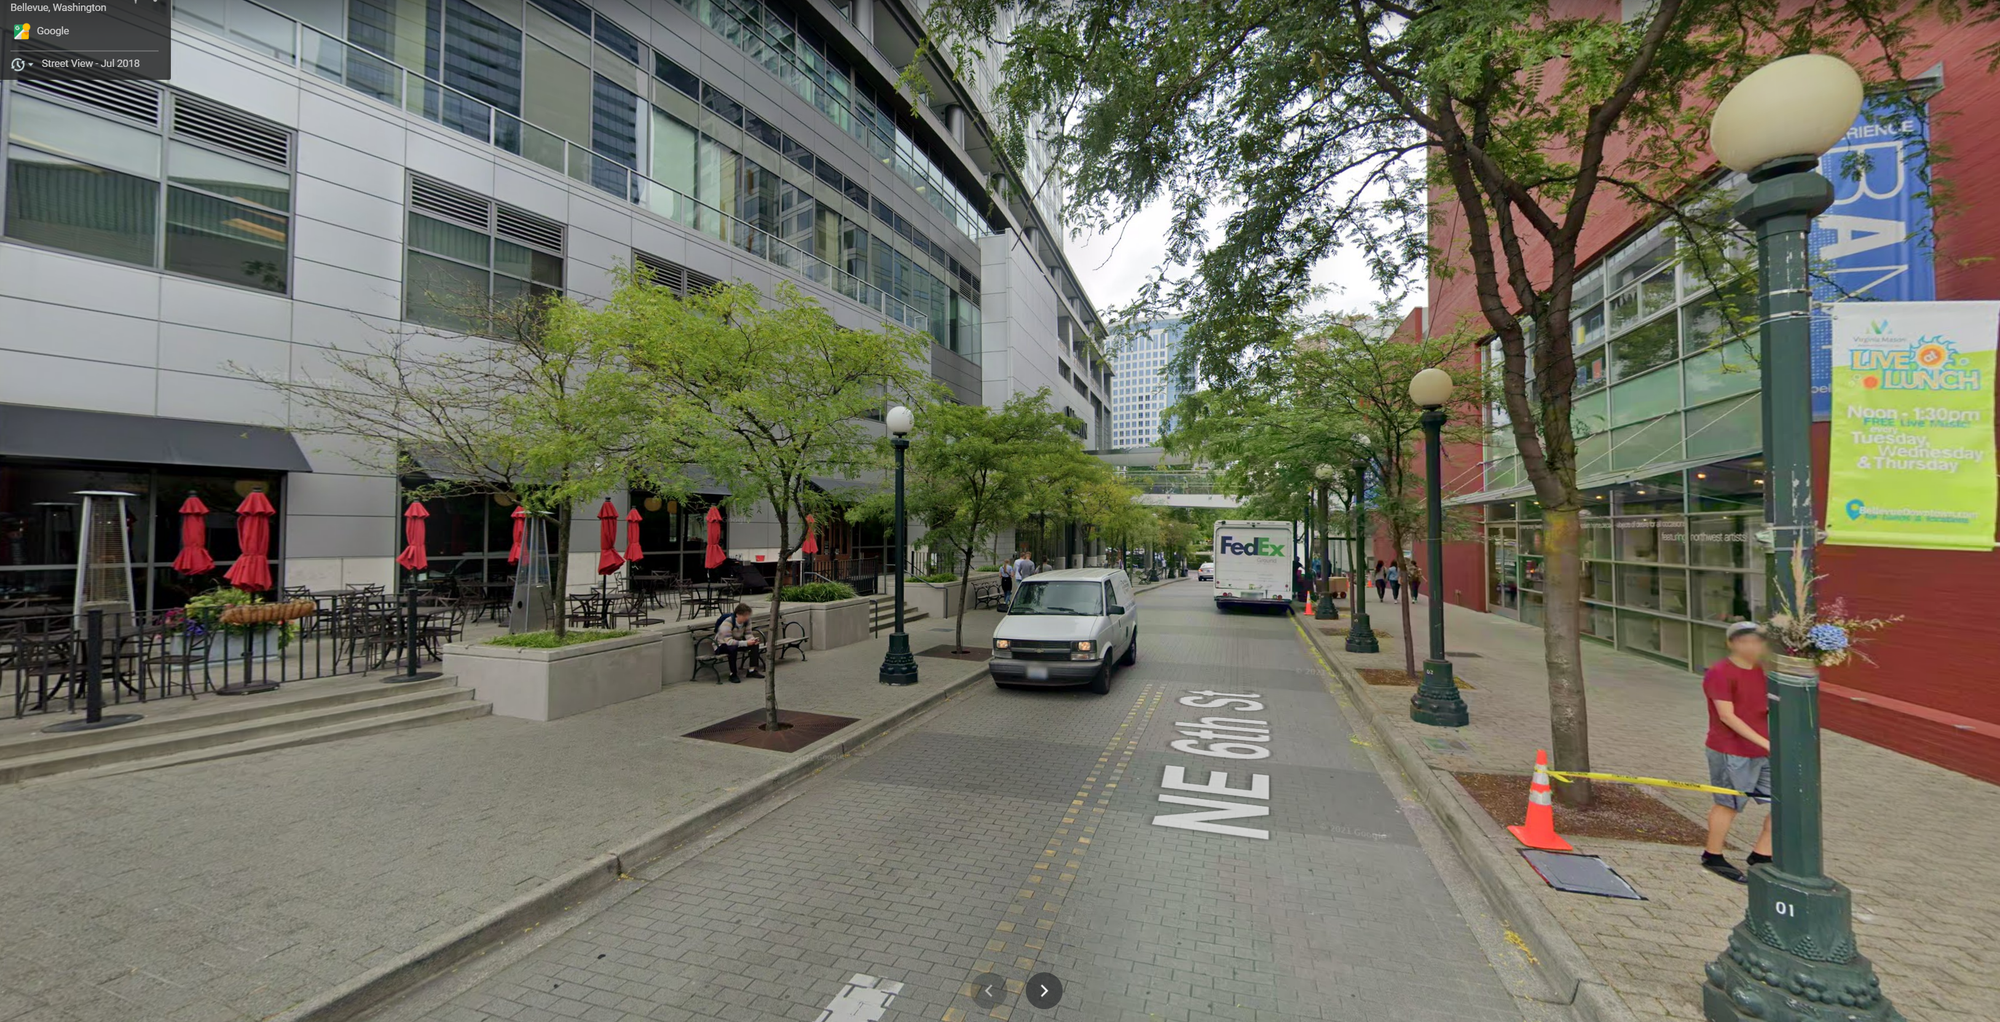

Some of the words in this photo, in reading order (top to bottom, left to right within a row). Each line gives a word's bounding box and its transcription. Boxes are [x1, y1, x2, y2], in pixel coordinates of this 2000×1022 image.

[1842, 119, 1915, 141] RIENCE
[1853, 336, 1881, 344] Virginia
[1850, 348, 1912, 371] LIVE
[1923, 350, 1939, 364] at
[1882, 368, 1981, 391] LUNCH
[1847, 405, 1898, 419] Noon
[1913, 406, 1981, 422] 1:30pm
[1863, 417, 1896, 427] FREE
[1900, 418, 1926, 428] Live
[1851, 430, 1931, 448] Tuesday,
[1877, 444, 1984, 463] Wednesday
[1856, 455, 1872, 469] &
[1873, 456, 1959, 473] Thursday
[1220, 535, 1285, 557] FedEx
[1661, 532, 1687, 544] featuring
[1689, 532, 1723, 543] northwest
[1775, 900, 1795, 917] 01
